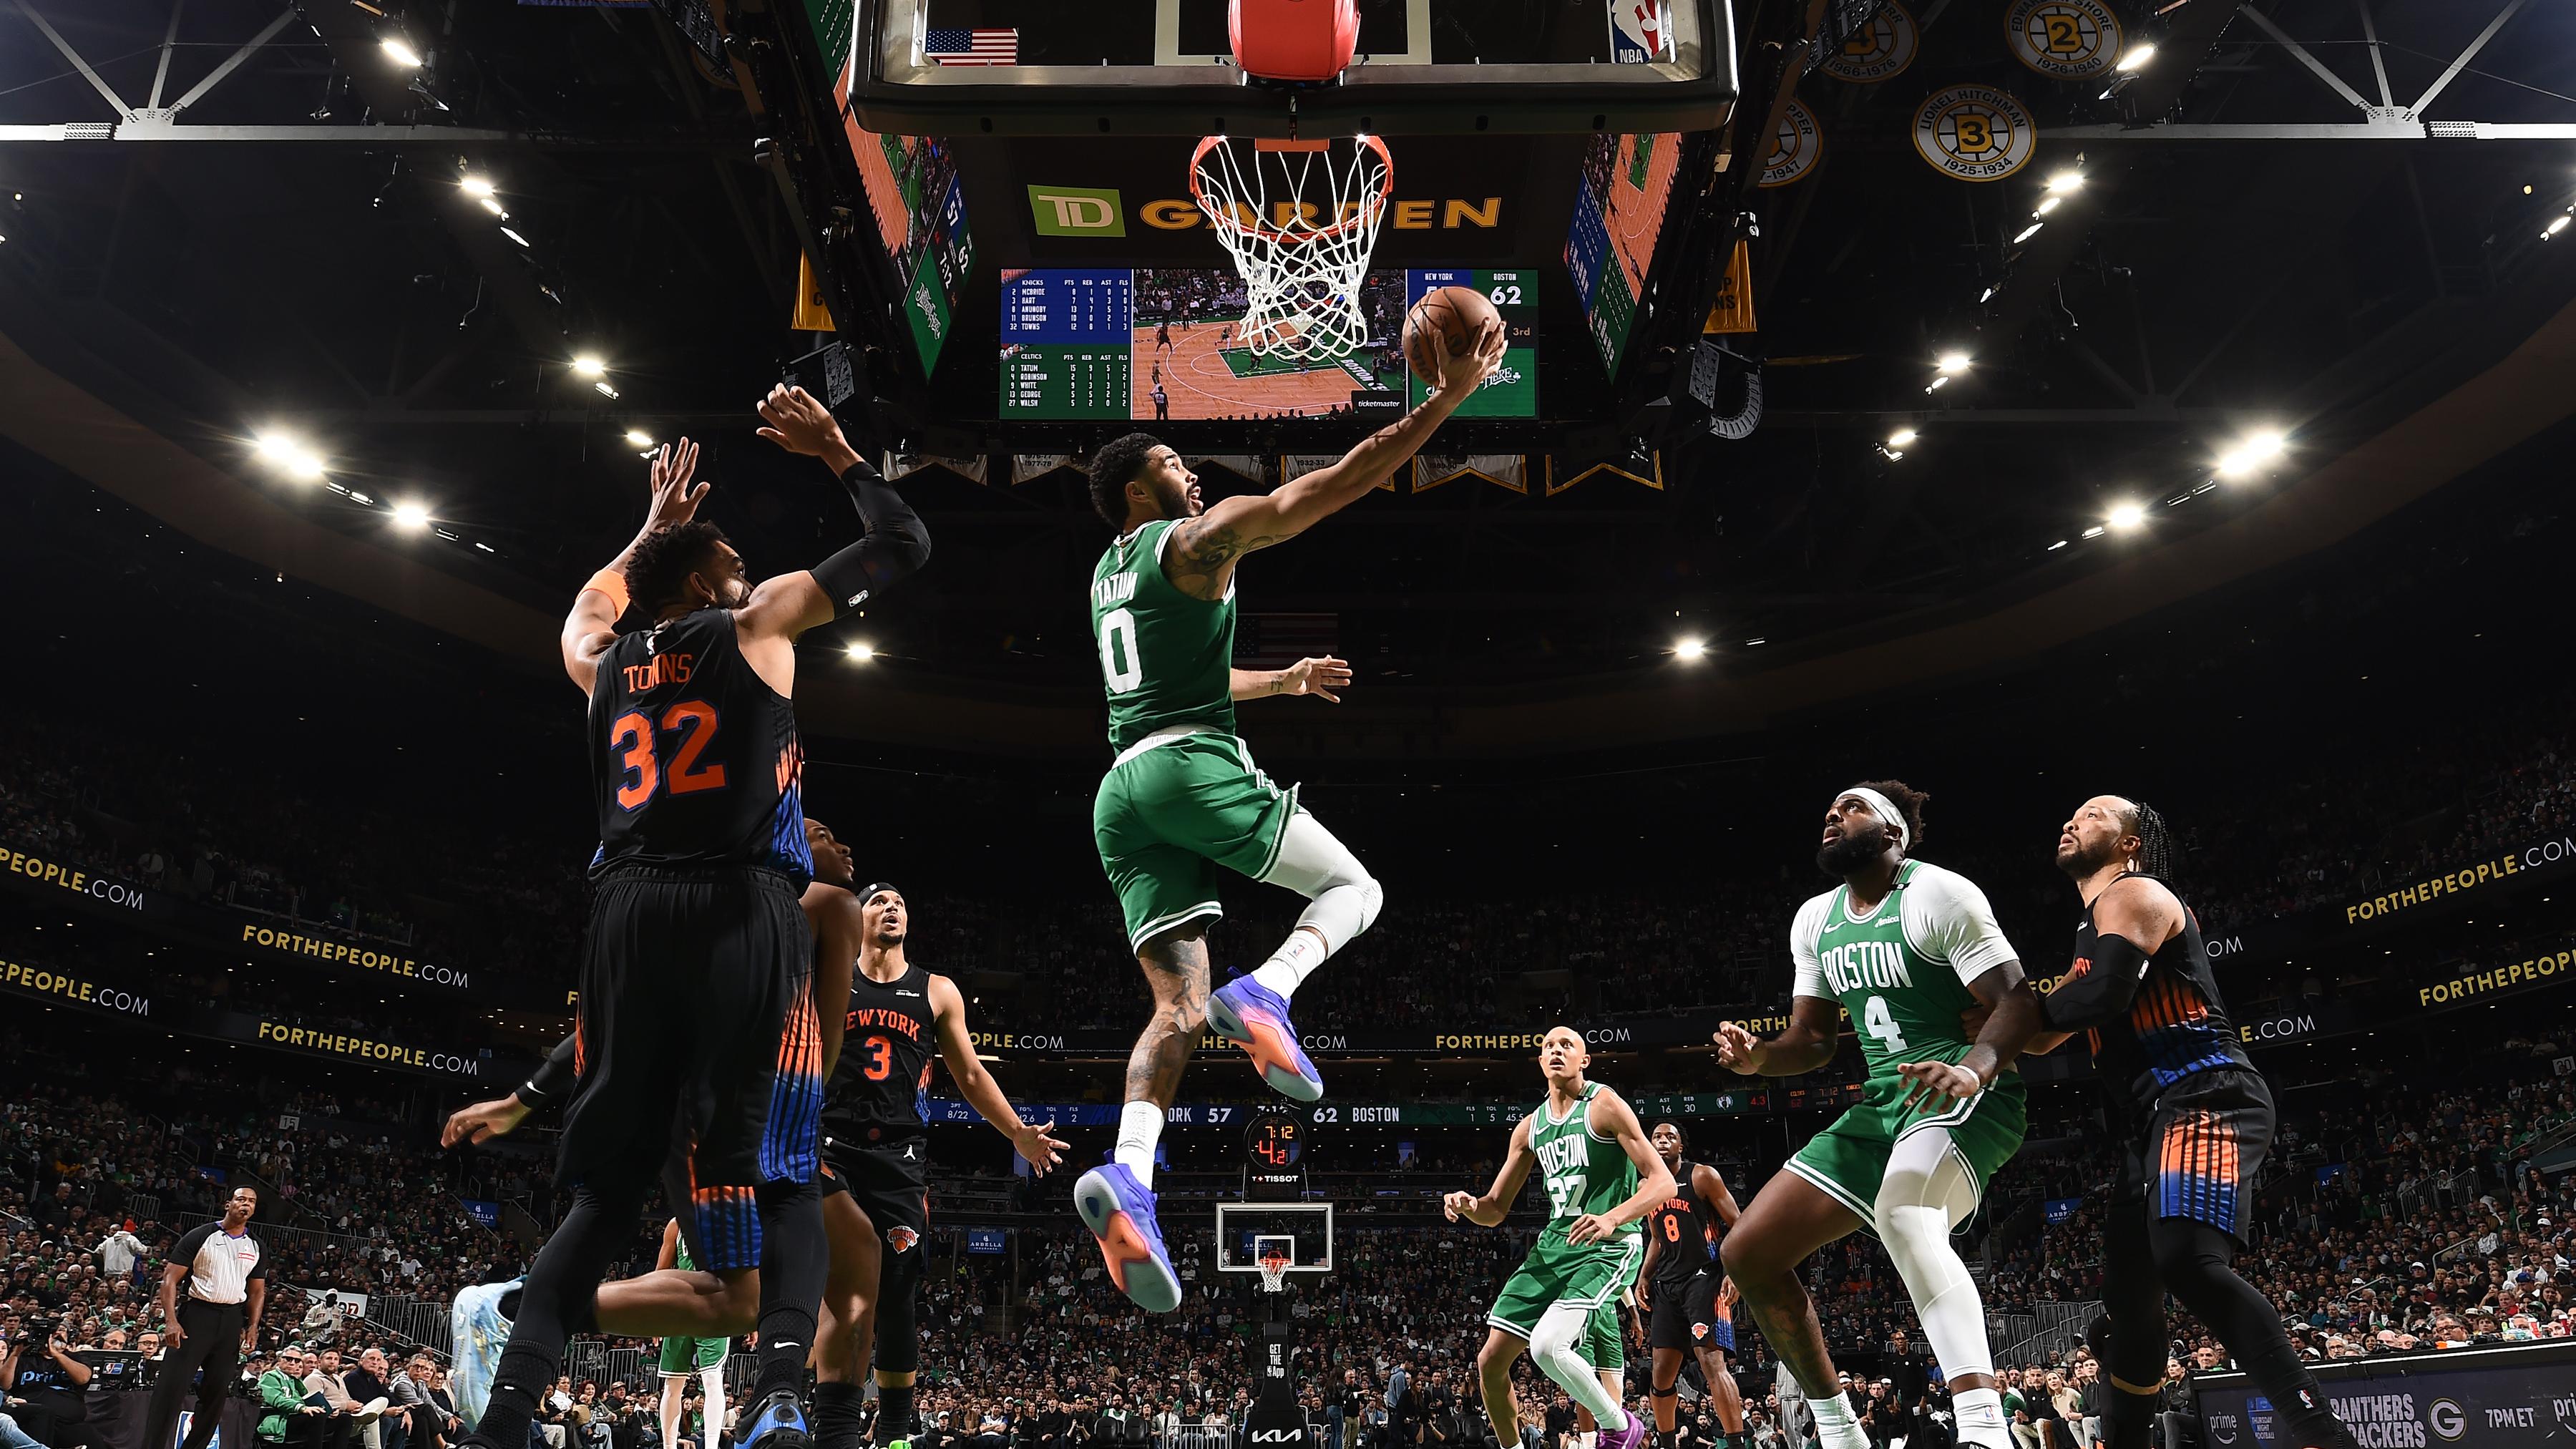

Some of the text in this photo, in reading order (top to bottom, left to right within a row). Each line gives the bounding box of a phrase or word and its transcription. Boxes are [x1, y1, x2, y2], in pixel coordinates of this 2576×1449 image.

[1884, 6, 1904, 24] RR
[2051, 21, 2076, 46] 2
[1619, 49, 1644, 64] NBA
[2036, 57, 2102, 74] 1926-1940
[1920, 90, 2026, 130] LIONEL HITCHMAN
[1961, 121, 1986, 147] 3
[1943, 157, 2014, 176] 1925-1934
[1038, 195, 1115, 228] TD
[1425, 273, 1453, 281] NEW YORK
[1493, 273, 1517, 281] BOSTON
[1490, 286, 1522, 305] 62
[1513, 327, 1531, 336] 3rd
[1358, 399, 1400, 408] ticketmaster
[1096, 572, 1138, 608] TATUM
[1101, 608, 1142, 694] 0
[610, 698, 728, 814] 32
[243, 924, 469, 988] FORTHEPEOPLE.COM
[1820, 941, 1913, 997] BOSTON
[846, 1009, 920, 1042] EW YORK
[1864, 995, 1908, 1053] 4
[259, 1022, 477, 1075] FORTHEPEOPLE.COM
[863, 1035, 892, 1081] 3
[1639, 1104, 1696, 1116] 4 16 30
[1750, 1096, 1766, 1106] 4.3
[947, 1110, 968, 1120] 8/22
[1049, 1114, 1055, 1123] 3
[1071, 1114, 1077, 1123] 2
[1168, 1107, 1400, 1123] ORK 57 62 BOSTON
[1489, 1113, 1496, 1123] 5
[1506, 1113, 1524, 1123] 45.5
[1265, 1126, 1293, 1139] 7:12
[1259, 1140, 1285, 1164] 4.2
[1536, 1133, 1589, 1179] BOSTON
[1547, 1174, 1587, 1219] 27
[1665, 1198, 1691, 1213] YORK
[1663, 1214, 1680, 1243] 8
[1269, 1344, 1282, 1355] GET
[1269, 1355, 1282, 1365] THE
[1272, 1366, 1284, 1378] App
[2330, 1393, 2415, 1423] PANTHERS
[2210, 1411, 2238, 1433] prime
[1252, 1428, 1302, 1443] KIA
